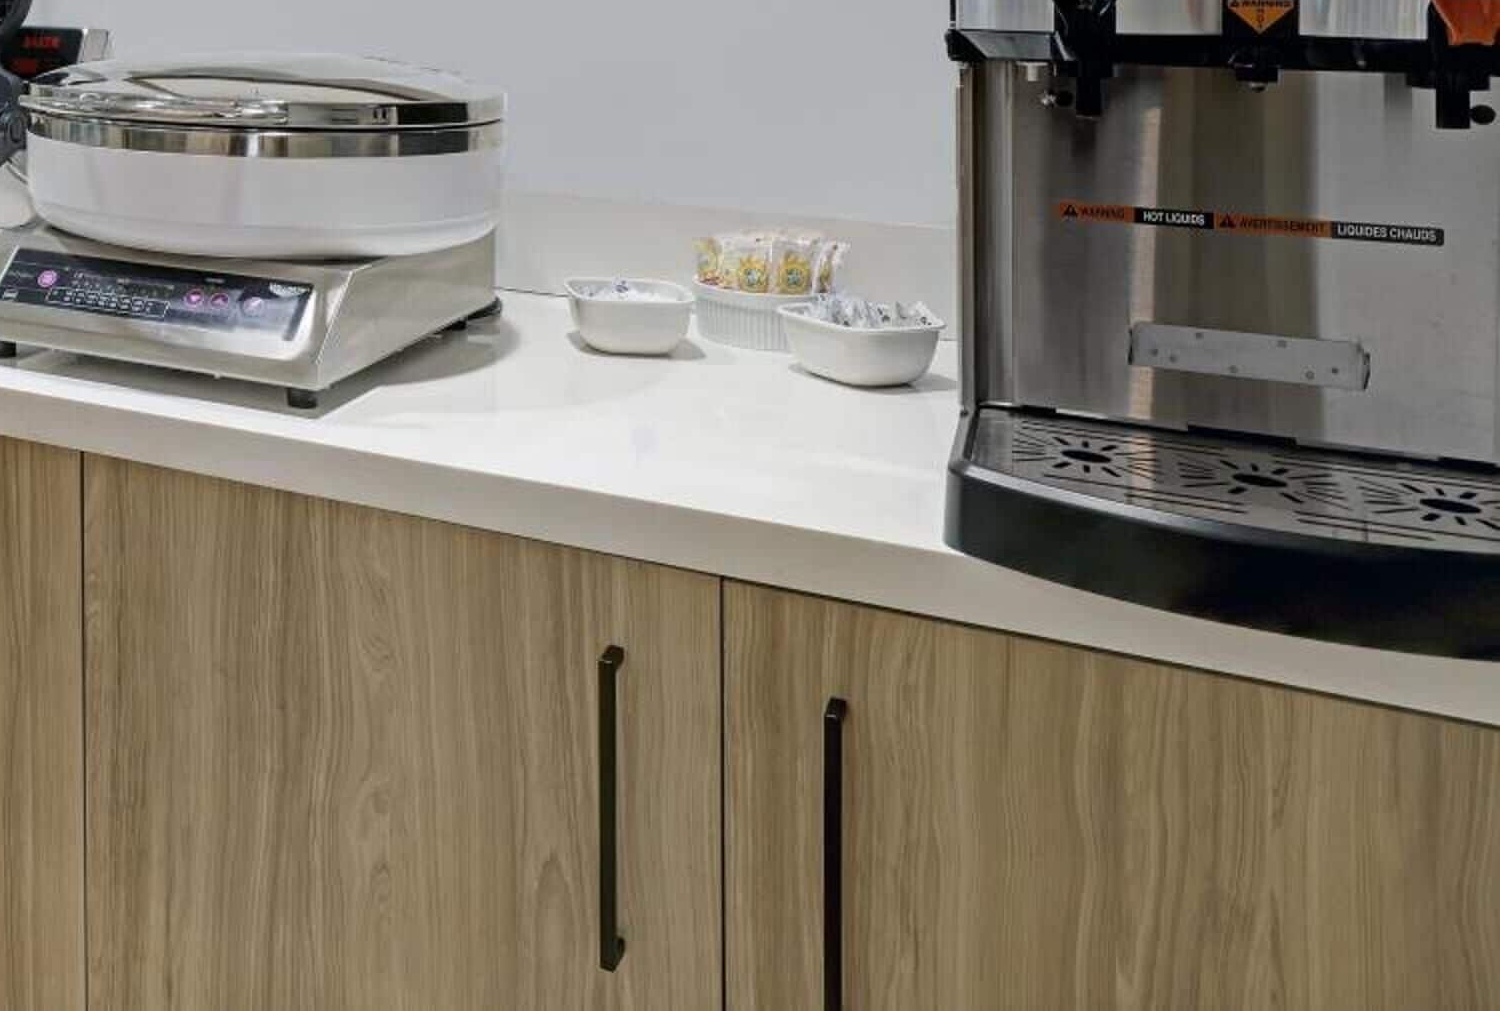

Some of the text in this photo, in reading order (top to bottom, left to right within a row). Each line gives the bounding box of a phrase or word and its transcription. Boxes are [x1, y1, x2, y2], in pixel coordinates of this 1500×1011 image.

[1142, 210, 1164, 222] HOT
[1165, 211, 1206, 226] LIQUIDS
[1336, 224, 1388, 239] LIQUIDES
[1389, 227, 1438, 242] CHAUDS
